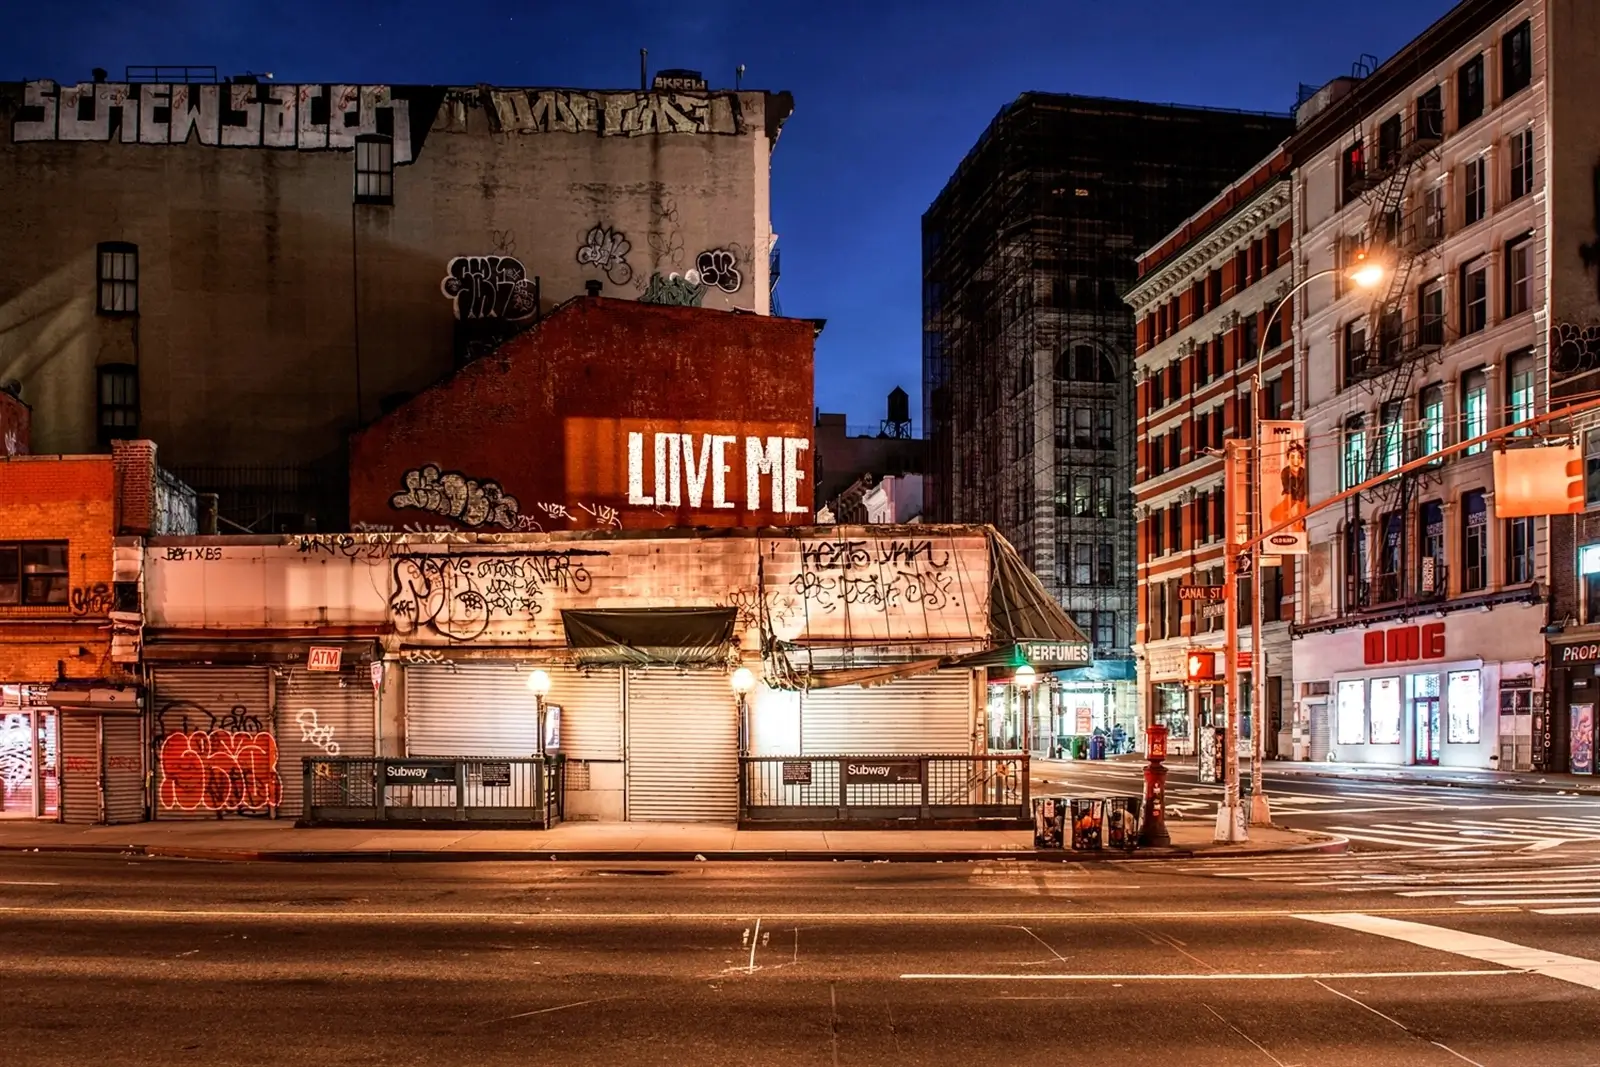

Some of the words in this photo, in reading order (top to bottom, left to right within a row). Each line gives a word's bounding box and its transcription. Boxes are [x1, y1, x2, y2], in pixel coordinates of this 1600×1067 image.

[1273, 427, 1291, 435] NYC
[627, 431, 737, 509] LOVE
[745, 436, 810, 513] ME
[1179, 587, 1207, 599] CANAL
[1210, 587, 1221, 599] ST
[1364, 622, 1446, 665] OMG
[312, 652, 338, 666] ATM
[387, 766, 428, 777] Subway
[848, 764, 890, 776] Subway
